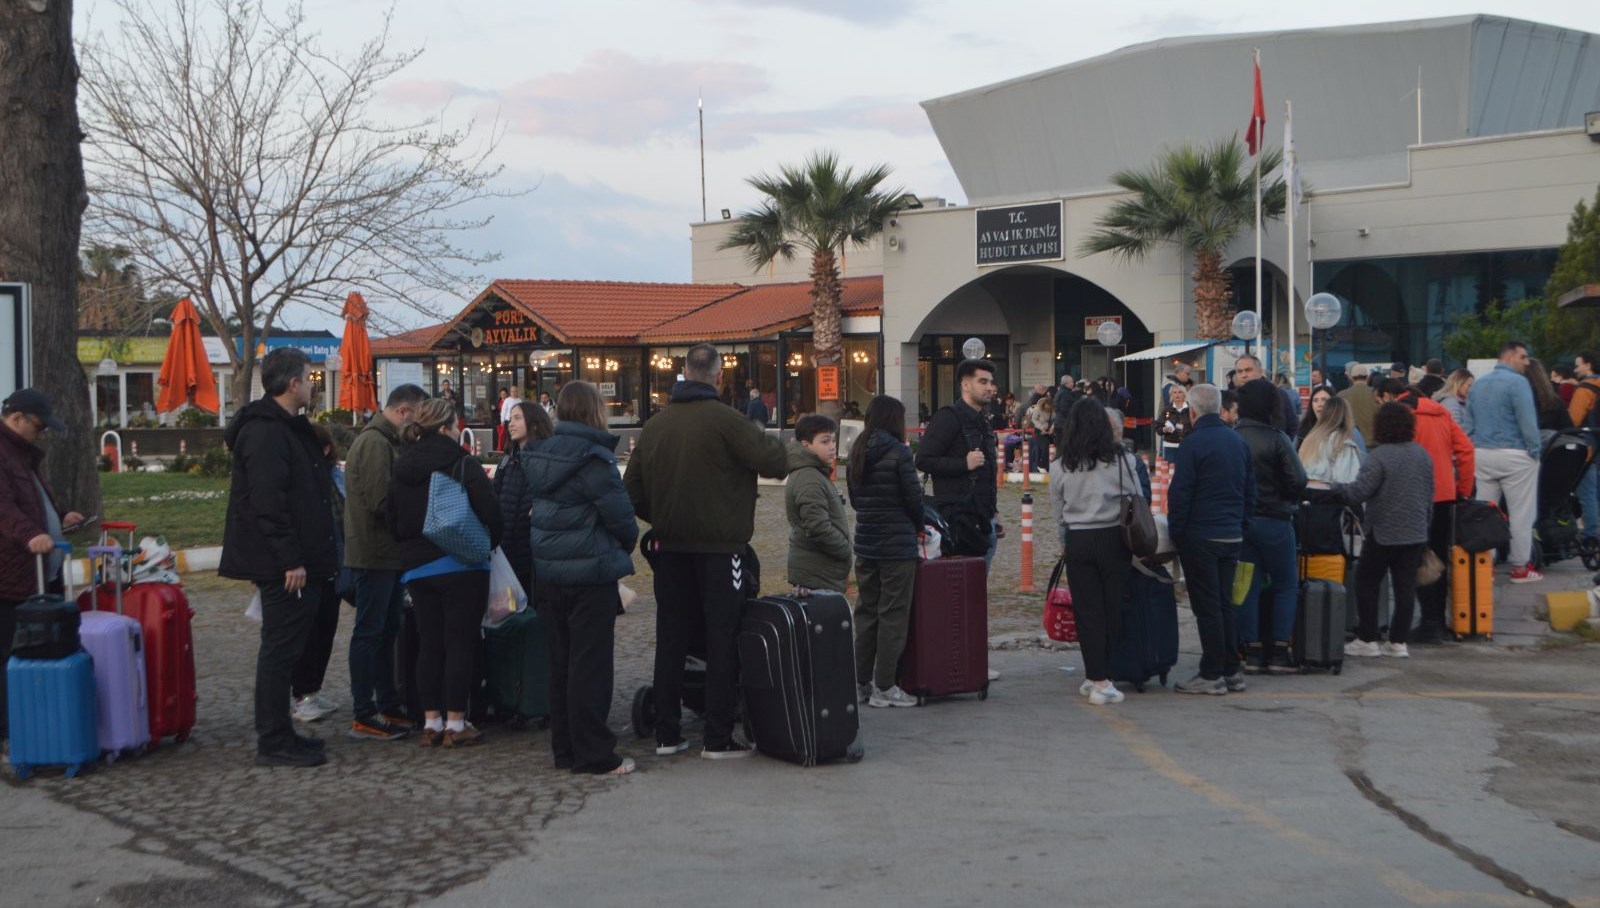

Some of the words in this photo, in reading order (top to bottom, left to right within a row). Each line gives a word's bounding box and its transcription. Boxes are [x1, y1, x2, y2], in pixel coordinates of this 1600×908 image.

[1009, 211, 1027, 223] T.C.
[1025, 224, 1057, 240] DENİZ
[980, 245, 1018, 259] HUDUT
[1020, 242, 1058, 256] KAPISI
[495, 311, 525, 325] PORT
[486, 327, 537, 344] AYVALIK
